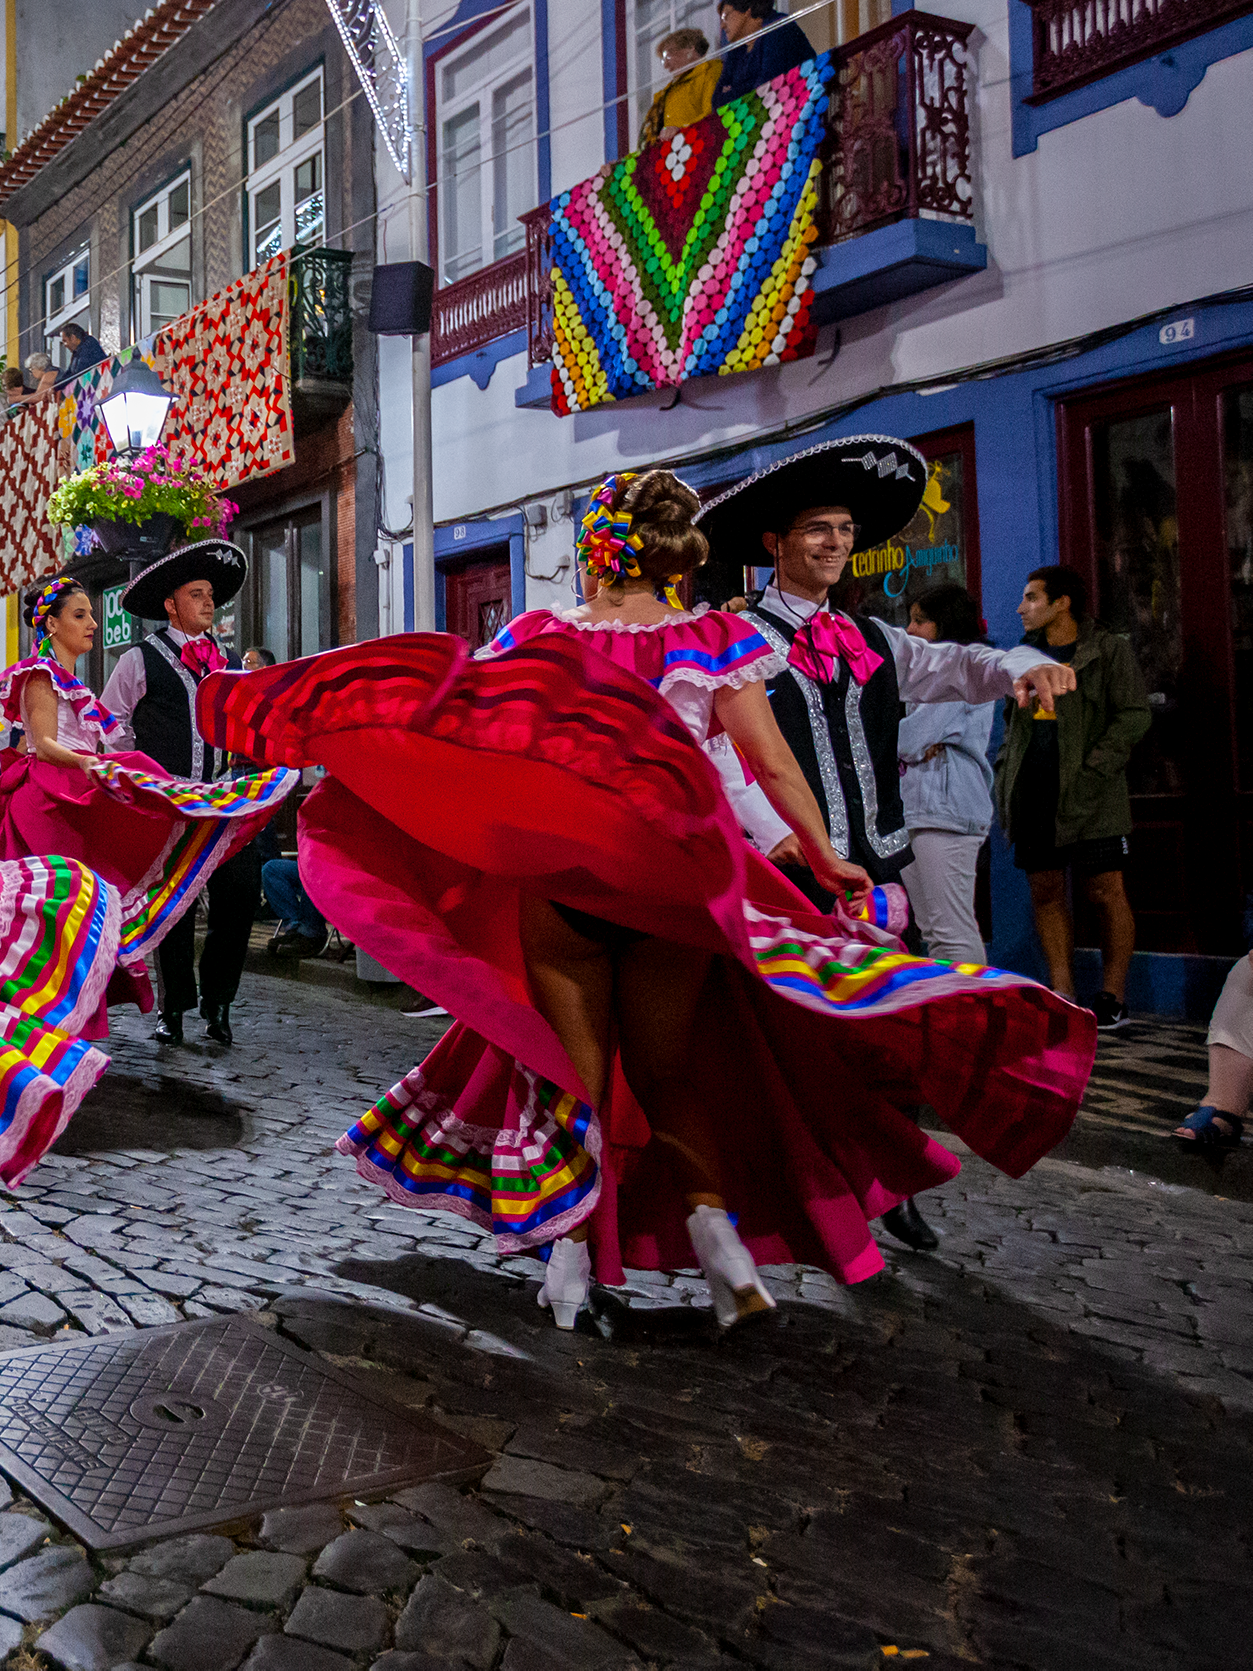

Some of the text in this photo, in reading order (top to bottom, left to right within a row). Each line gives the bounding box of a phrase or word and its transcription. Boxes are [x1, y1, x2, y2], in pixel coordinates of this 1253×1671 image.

[1165, 322, 1190, 341] 94
[455, 527, 465, 538] 98
[106, 613, 131, 644] beb
[11, 1402, 99, 1469] SANEAMENTO
